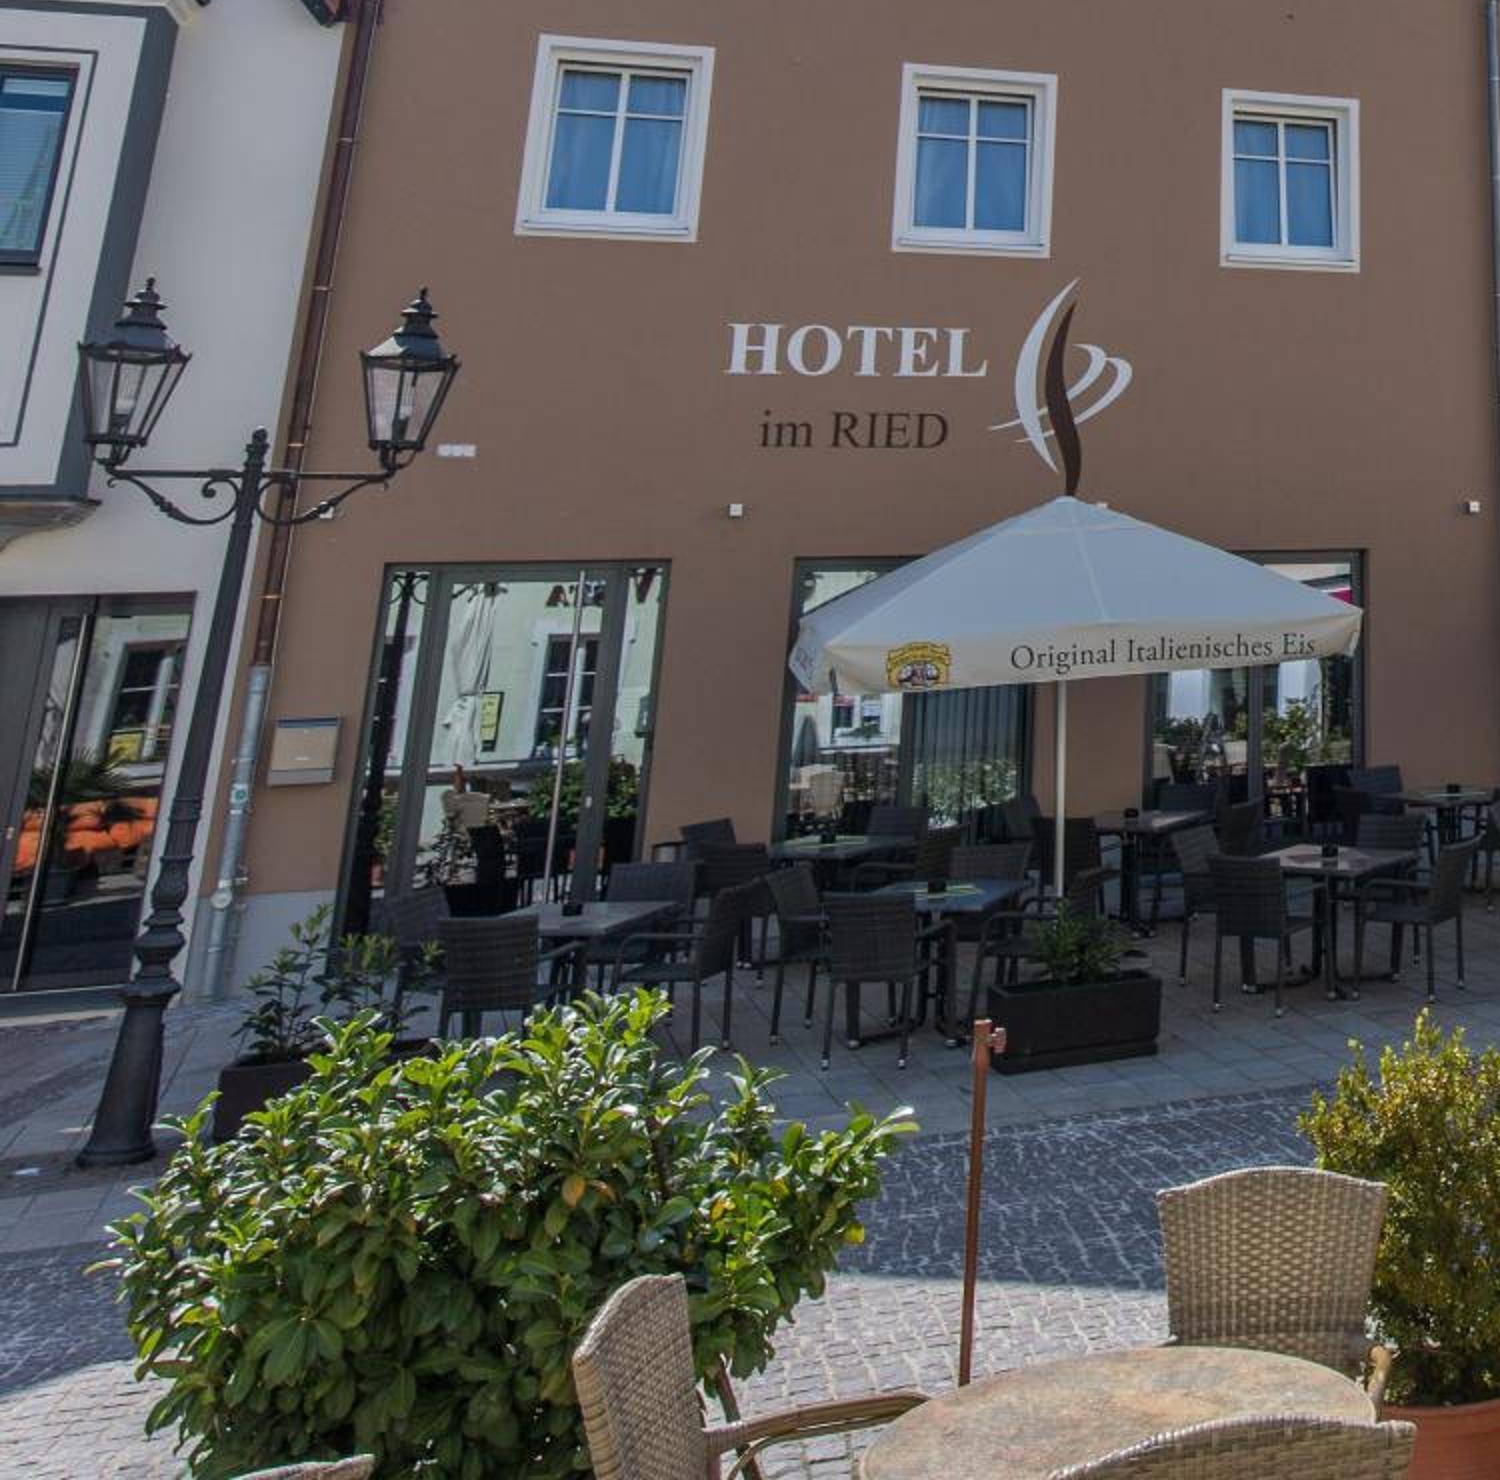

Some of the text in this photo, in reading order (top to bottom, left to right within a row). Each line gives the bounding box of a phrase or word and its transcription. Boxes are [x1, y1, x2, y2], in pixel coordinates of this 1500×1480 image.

[725, 322, 989, 377] HOTEL
[759, 409, 949, 449] im RIED
[1010, 632, 1317, 675] Original Italienisches Eis
